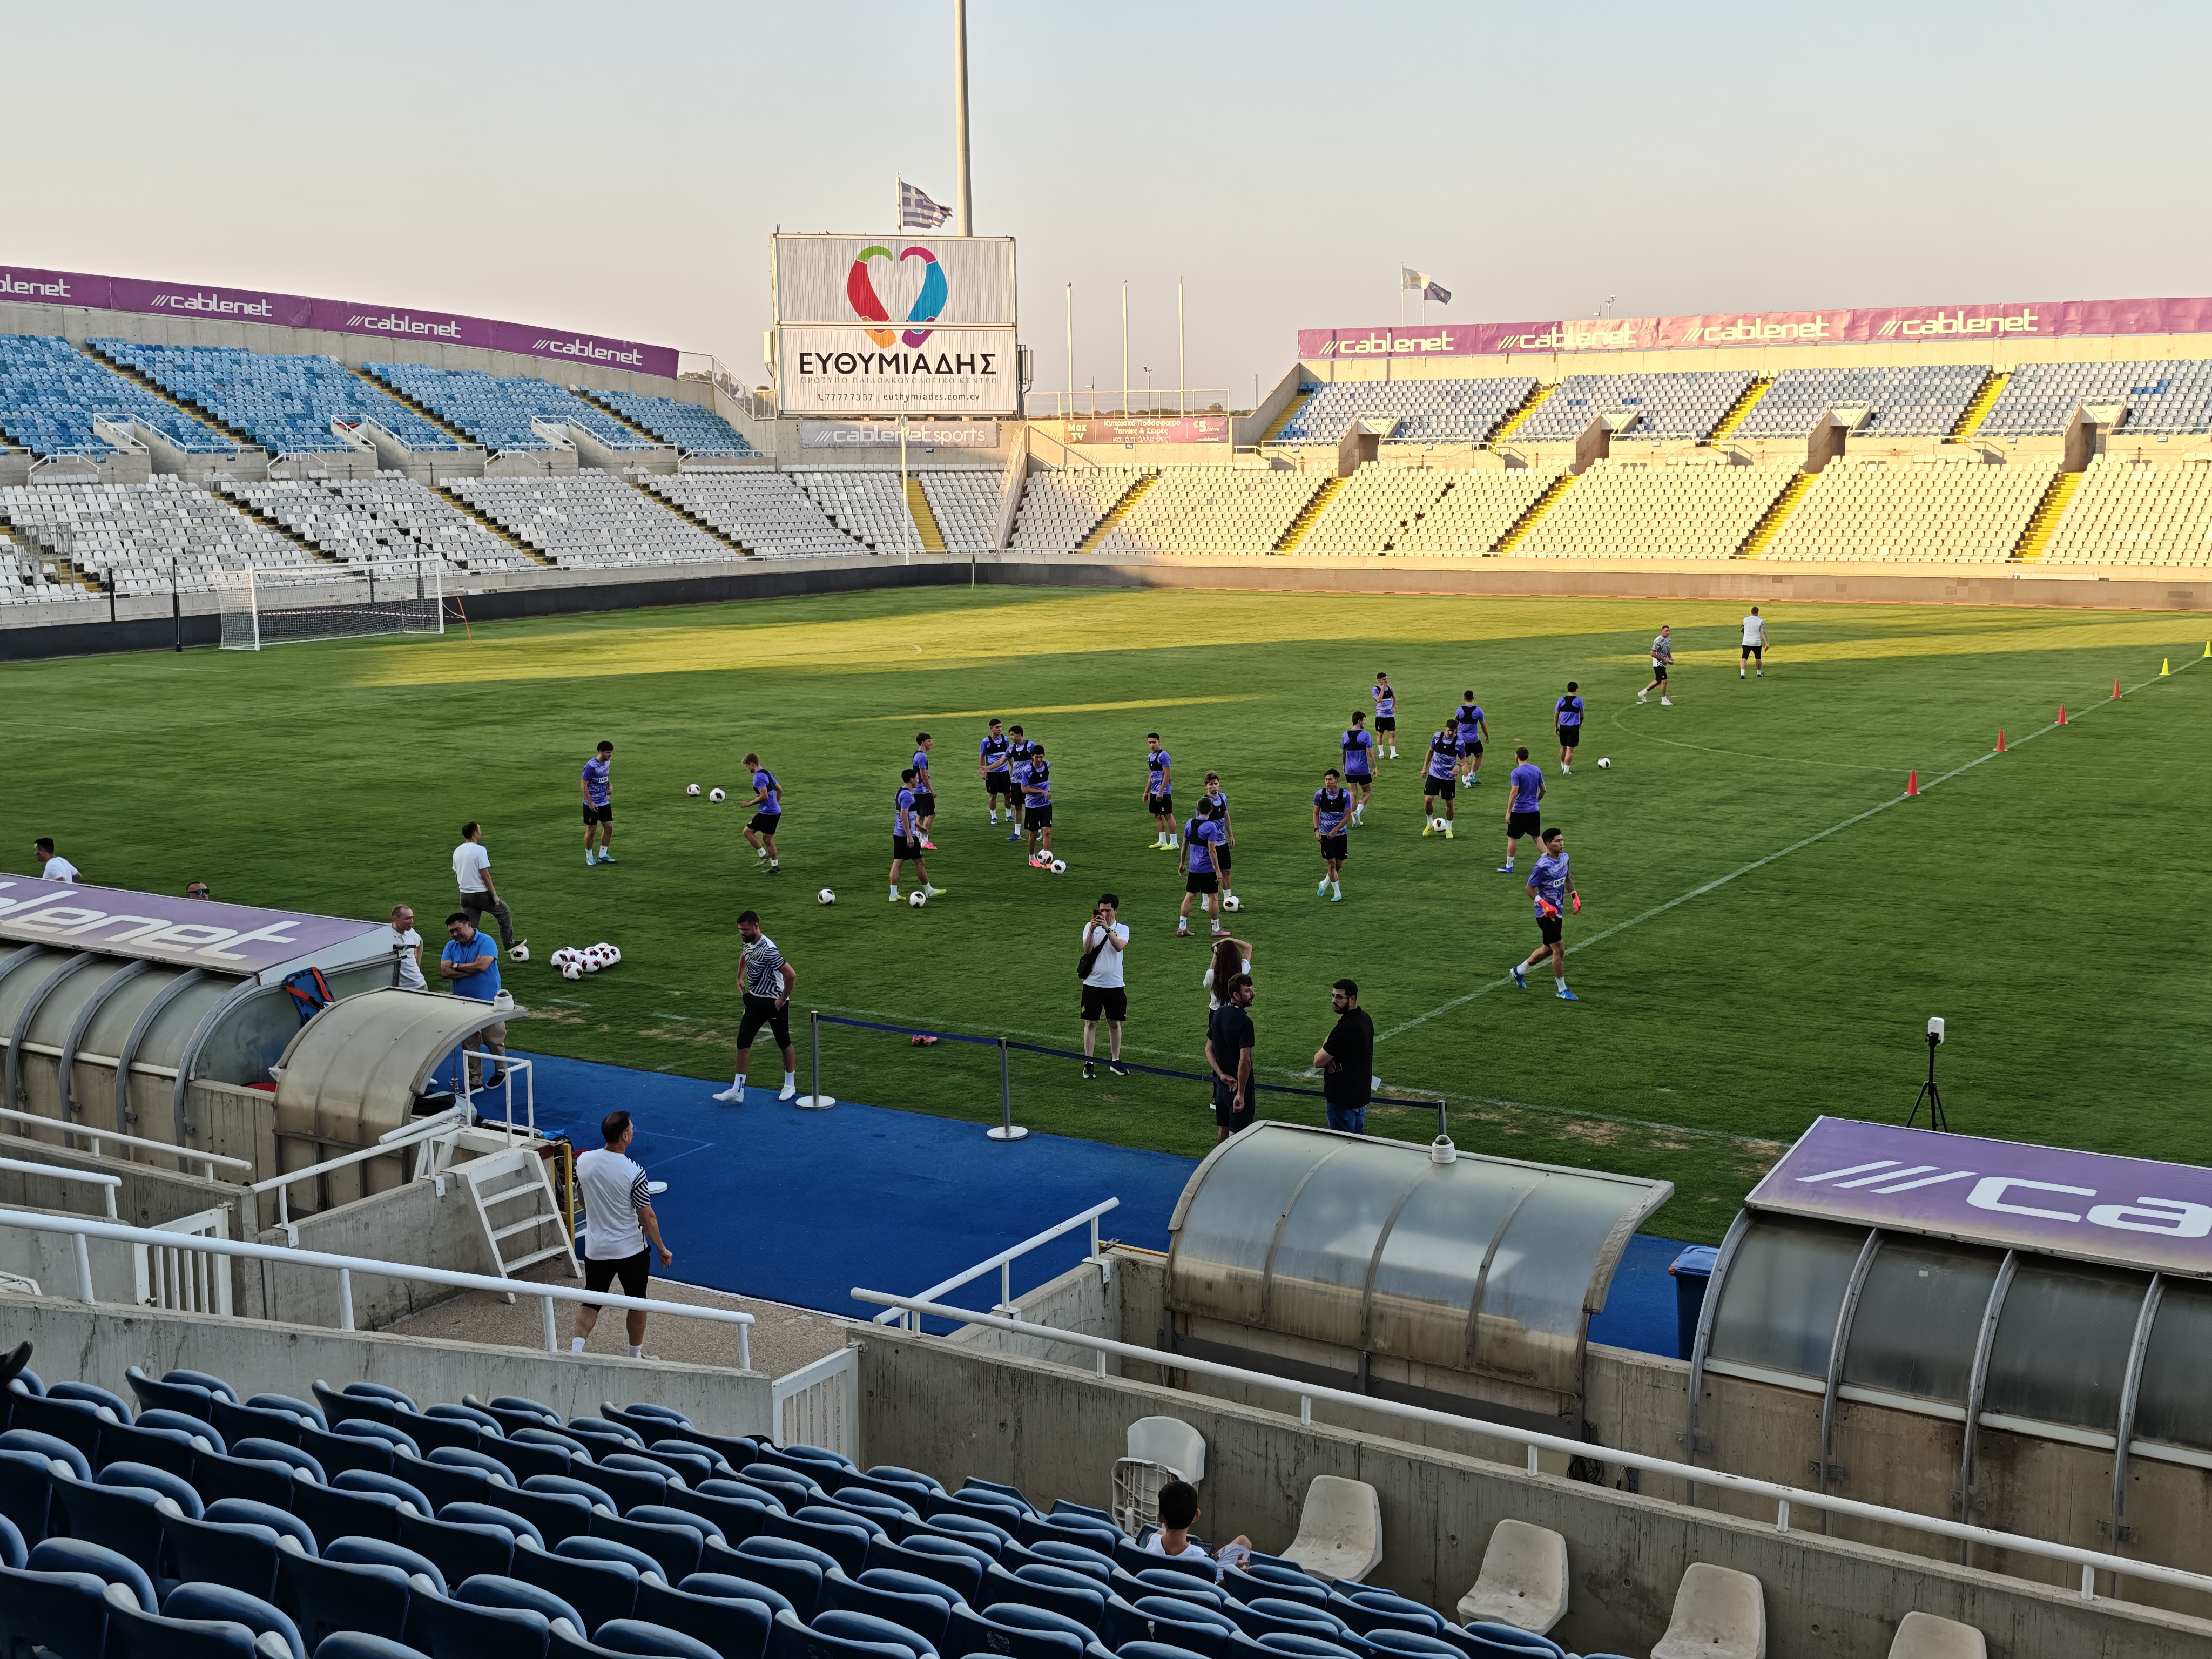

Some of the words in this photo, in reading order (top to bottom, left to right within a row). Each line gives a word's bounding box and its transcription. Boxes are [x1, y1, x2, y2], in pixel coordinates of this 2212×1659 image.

[170, 293, 272, 317] cablenet
[364, 314, 462, 338] cablenet
[1704, 315, 1830, 341] cablenet
[1902, 308, 2039, 335] cablenet
[1340, 331, 1455, 354] cablenet
[1520, 326, 1637, 348] cablenet
[550, 339, 643, 366] cablenet
[799, 352, 997, 375] ΕΥΘΥΜΙΑΔΗΣ
[884, 393, 980, 403] euthymiades.com.cy
[1068, 423, 1087, 431] Max
[1071, 432, 1084, 441] TV
